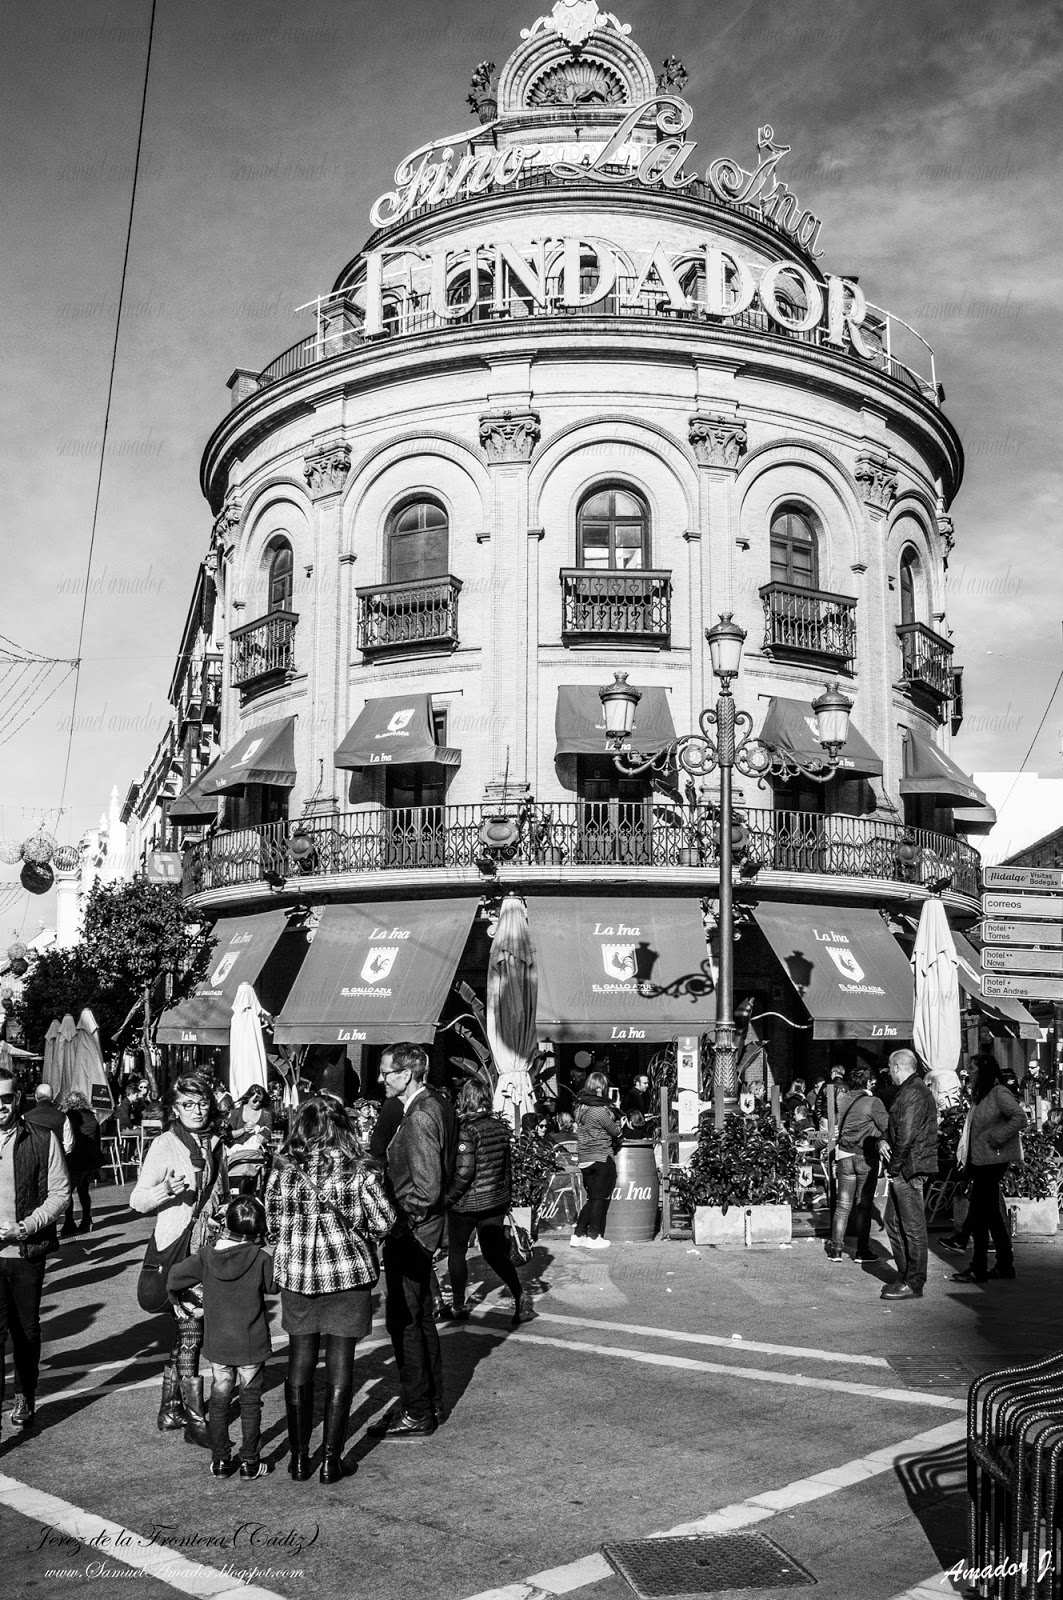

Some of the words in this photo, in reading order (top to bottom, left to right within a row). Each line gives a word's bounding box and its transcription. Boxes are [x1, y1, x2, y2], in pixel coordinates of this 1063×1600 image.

[369, 119, 539, 228] Fino
[550, 95, 698, 189] La
[706, 124, 825, 260] Ina
[361, 235, 878, 359] FUNDADOR
[989, 871, 1027, 882] Hidalgo
[1029, 871, 1053, 880] Visitas
[1029, 878, 1058, 886] Bodegas
[987, 900, 1022, 909] correos
[367, 927, 388, 940] La
[387, 927, 411, 940] Ina
[592, 922, 614, 935] La
[616, 923, 641, 936] Ina
[987, 924, 1007, 932] hotel
[812, 929, 831, 942] La
[829, 930, 849, 943] Ina
[987, 932, 1011, 940] Torres
[986, 951, 1005, 959] hotel
[986, 959, 1005, 967] Nova
[986, 986, 1001, 994] San
[1002, 987, 1028, 996] Andres
[336, 1029, 351, 1041] La
[350, 1028, 367, 1041] Ina
[610, 1026, 627, 1039] La
[627, 1026, 646, 1039] Ina
[870, 1024, 883, 1036] La
[883, 1024, 898, 1036] Ina
[624, 1180, 652, 1201] Ina
